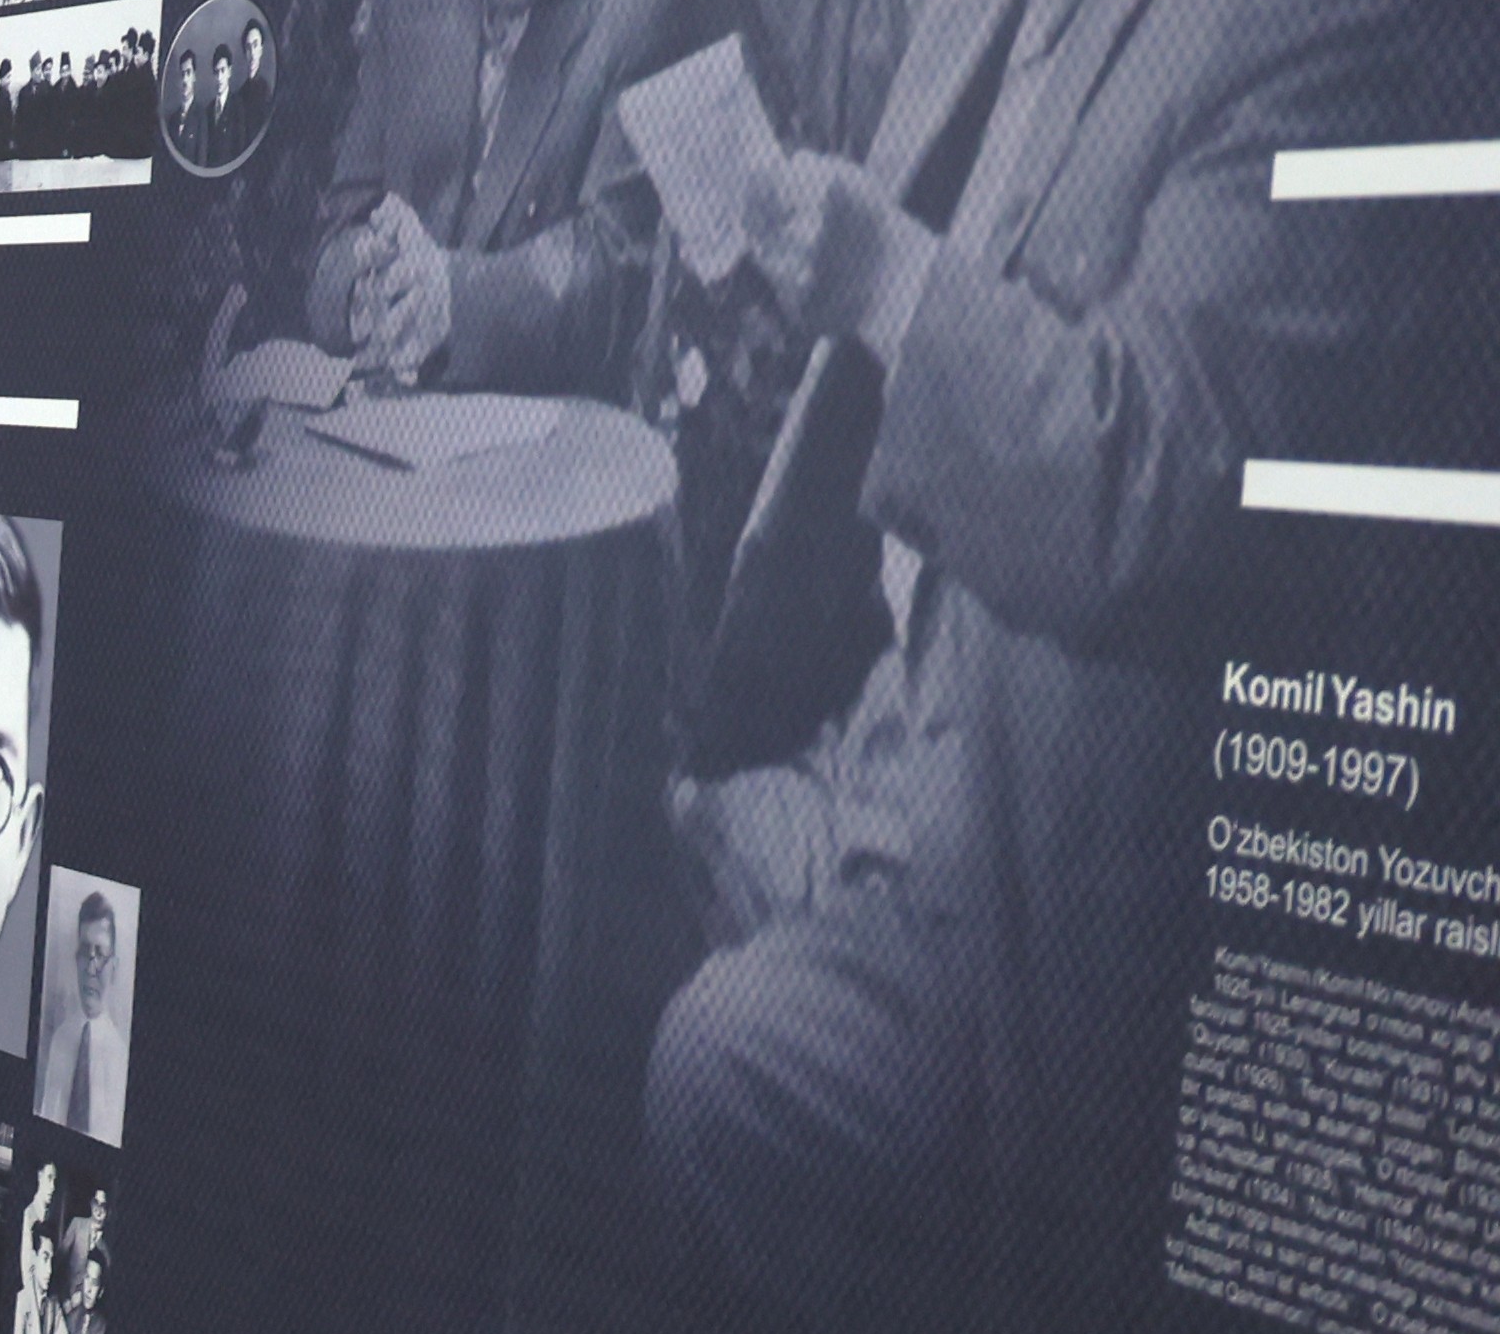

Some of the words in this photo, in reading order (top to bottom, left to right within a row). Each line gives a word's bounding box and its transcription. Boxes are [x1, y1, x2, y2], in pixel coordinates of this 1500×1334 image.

[1221, 660, 1324, 715] Komil
[1330, 674, 1457, 735] Yashin
[1213, 727, 1420, 812] (1909-1997)
[1207, 813, 1369, 878] O'zbekiston
[1205, 864, 1351, 929] 1958-1982
[1358, 896, 1428, 940] yillar
[1434, 913, 1500, 960] raisl
